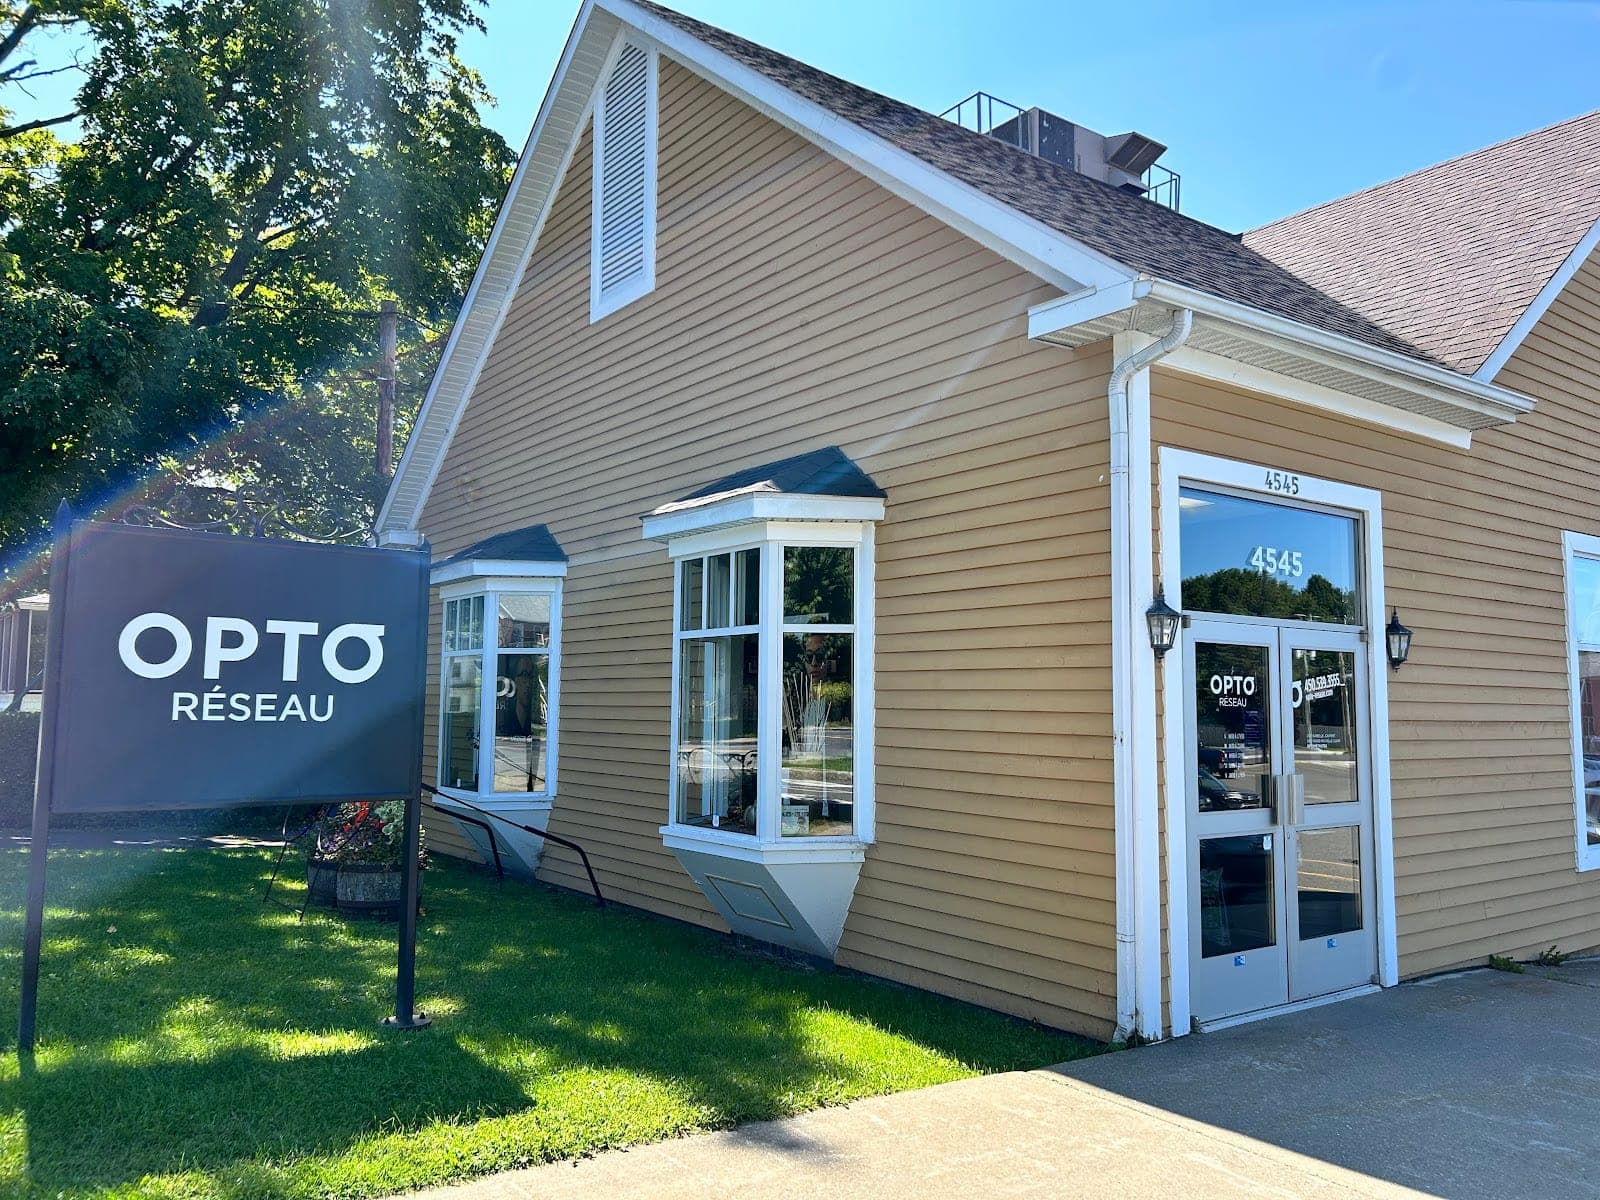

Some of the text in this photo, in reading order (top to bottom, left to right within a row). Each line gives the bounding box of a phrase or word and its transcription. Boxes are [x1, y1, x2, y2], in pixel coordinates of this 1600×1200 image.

[1265, 471, 1299, 495] 4545
[1251, 546, 1303, 577] 4545
[118, 612, 385, 684] OPTO
[1210, 674, 1255, 696] OPTO
[172, 685, 335, 722] RÉSEAU
[1219, 696, 1247, 707] RÉSEAU
